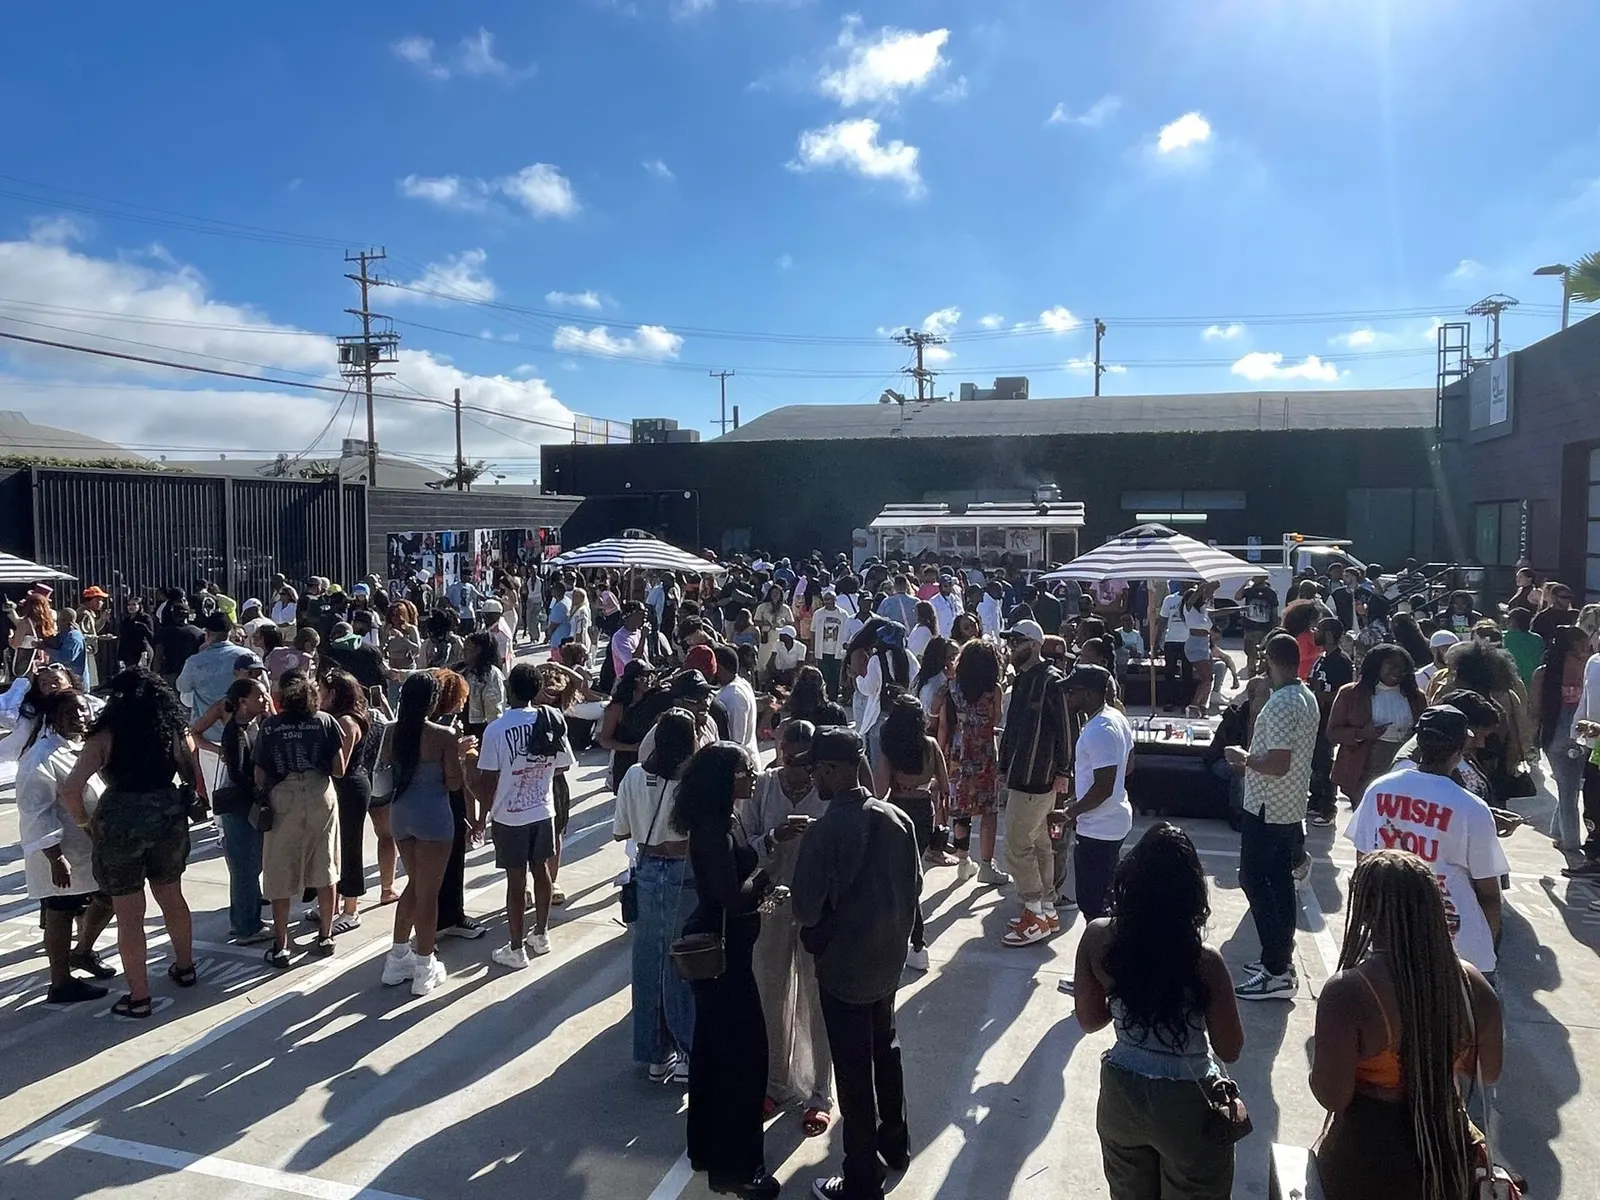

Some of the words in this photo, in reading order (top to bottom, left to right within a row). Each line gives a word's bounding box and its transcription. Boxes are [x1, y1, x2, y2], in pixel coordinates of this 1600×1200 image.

[1519, 514, 1527, 560] TUDIO
[1376, 792, 1453, 832] WISH
[1378, 826, 1440, 862] YOU
